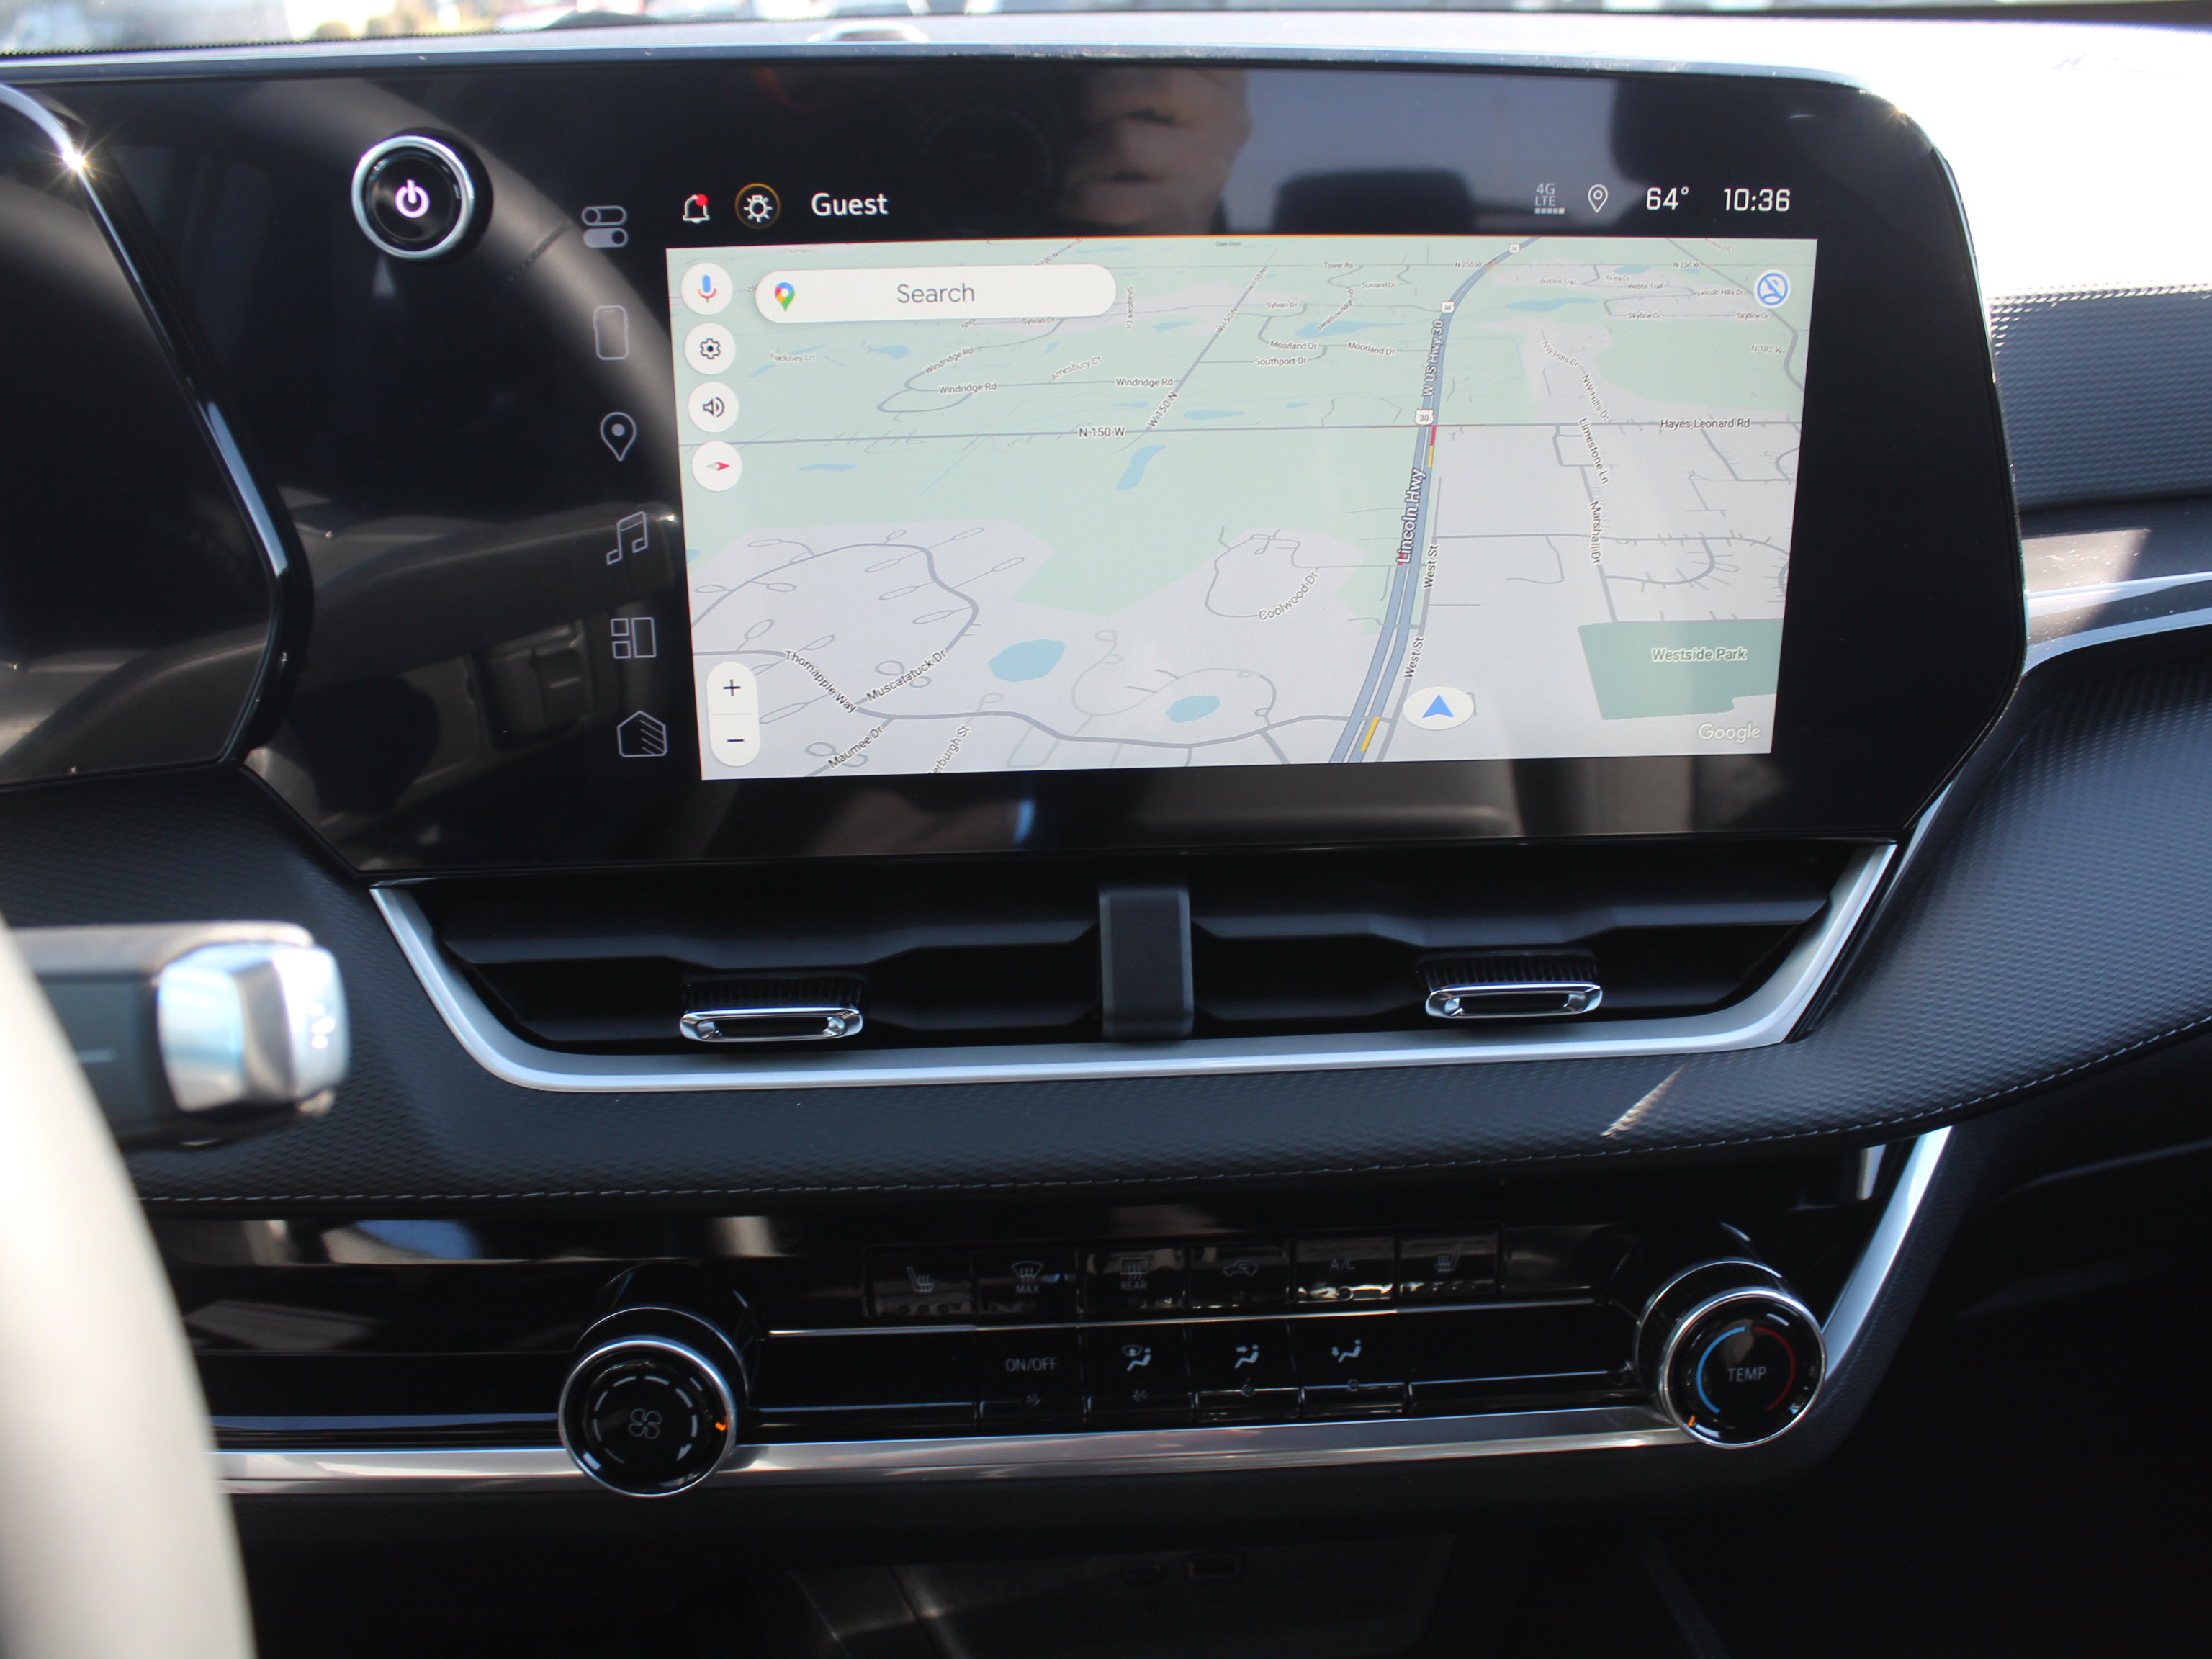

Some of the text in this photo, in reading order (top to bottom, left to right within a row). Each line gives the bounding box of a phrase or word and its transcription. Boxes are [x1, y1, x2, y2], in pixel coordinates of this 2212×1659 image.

[1537, 183, 1555, 194] 4G
[811, 192, 889, 216] Guest
[1534, 196, 1556, 206] LTE
[1724, 188, 1791, 212] 10:36
[897, 283, 975, 303] Search
[1222, 313, 1233, 326] 150
[1628, 311, 1652, 320] Skyline
[1735, 312, 1759, 320] Skyline
[1270, 341, 1306, 349] Moorland
[1348, 342, 1384, 354] Moorland
[1542, 341, 1579, 367] NW Hills Dr
[925, 346, 974, 373] Windridge Rd
[1255, 357, 1295, 366] Southport
[1422, 320, 1444, 396] W US Hwy 30
[1051, 360, 1090, 380] Amesbury
[938, 382, 997, 393] Windridge Rd
[1116, 379, 1159, 388] Windridge
[1582, 374, 1610, 421] NW Hills Dr
[1148, 391, 1177, 427] W 150 N
[1079, 426, 1125, 437] N 150 W
[1660, 418, 1750, 429] Hayes Leonard Rd
[1579, 418, 1609, 485] Limestone Ln
[1396, 468, 1427, 563] Lincoln Hwy
[1590, 500, 1602, 564] Marshall Dr
[1424, 545, 1438, 589] West St
[1259, 571, 1318, 620] Coolwood Dr
[1404, 637, 1424, 679] West St
[1652, 647, 1746, 661] Westside Park
[784, 650, 857, 714] Thornapple Way
[866, 649, 947, 702] Muscatatuck Dr
[956, 725, 971, 738] St
[1699, 723, 1761, 743] Google
[828, 725, 884, 768] Maumee Dr
[1330, 1258, 1354, 1271] A/C
[1015, 1285, 1040, 1294] MAX
[1120, 1281, 1148, 1290] REAR
[1005, 1357, 1058, 1372] ON/OFF
[1728, 1366, 1767, 1382] TEMP
